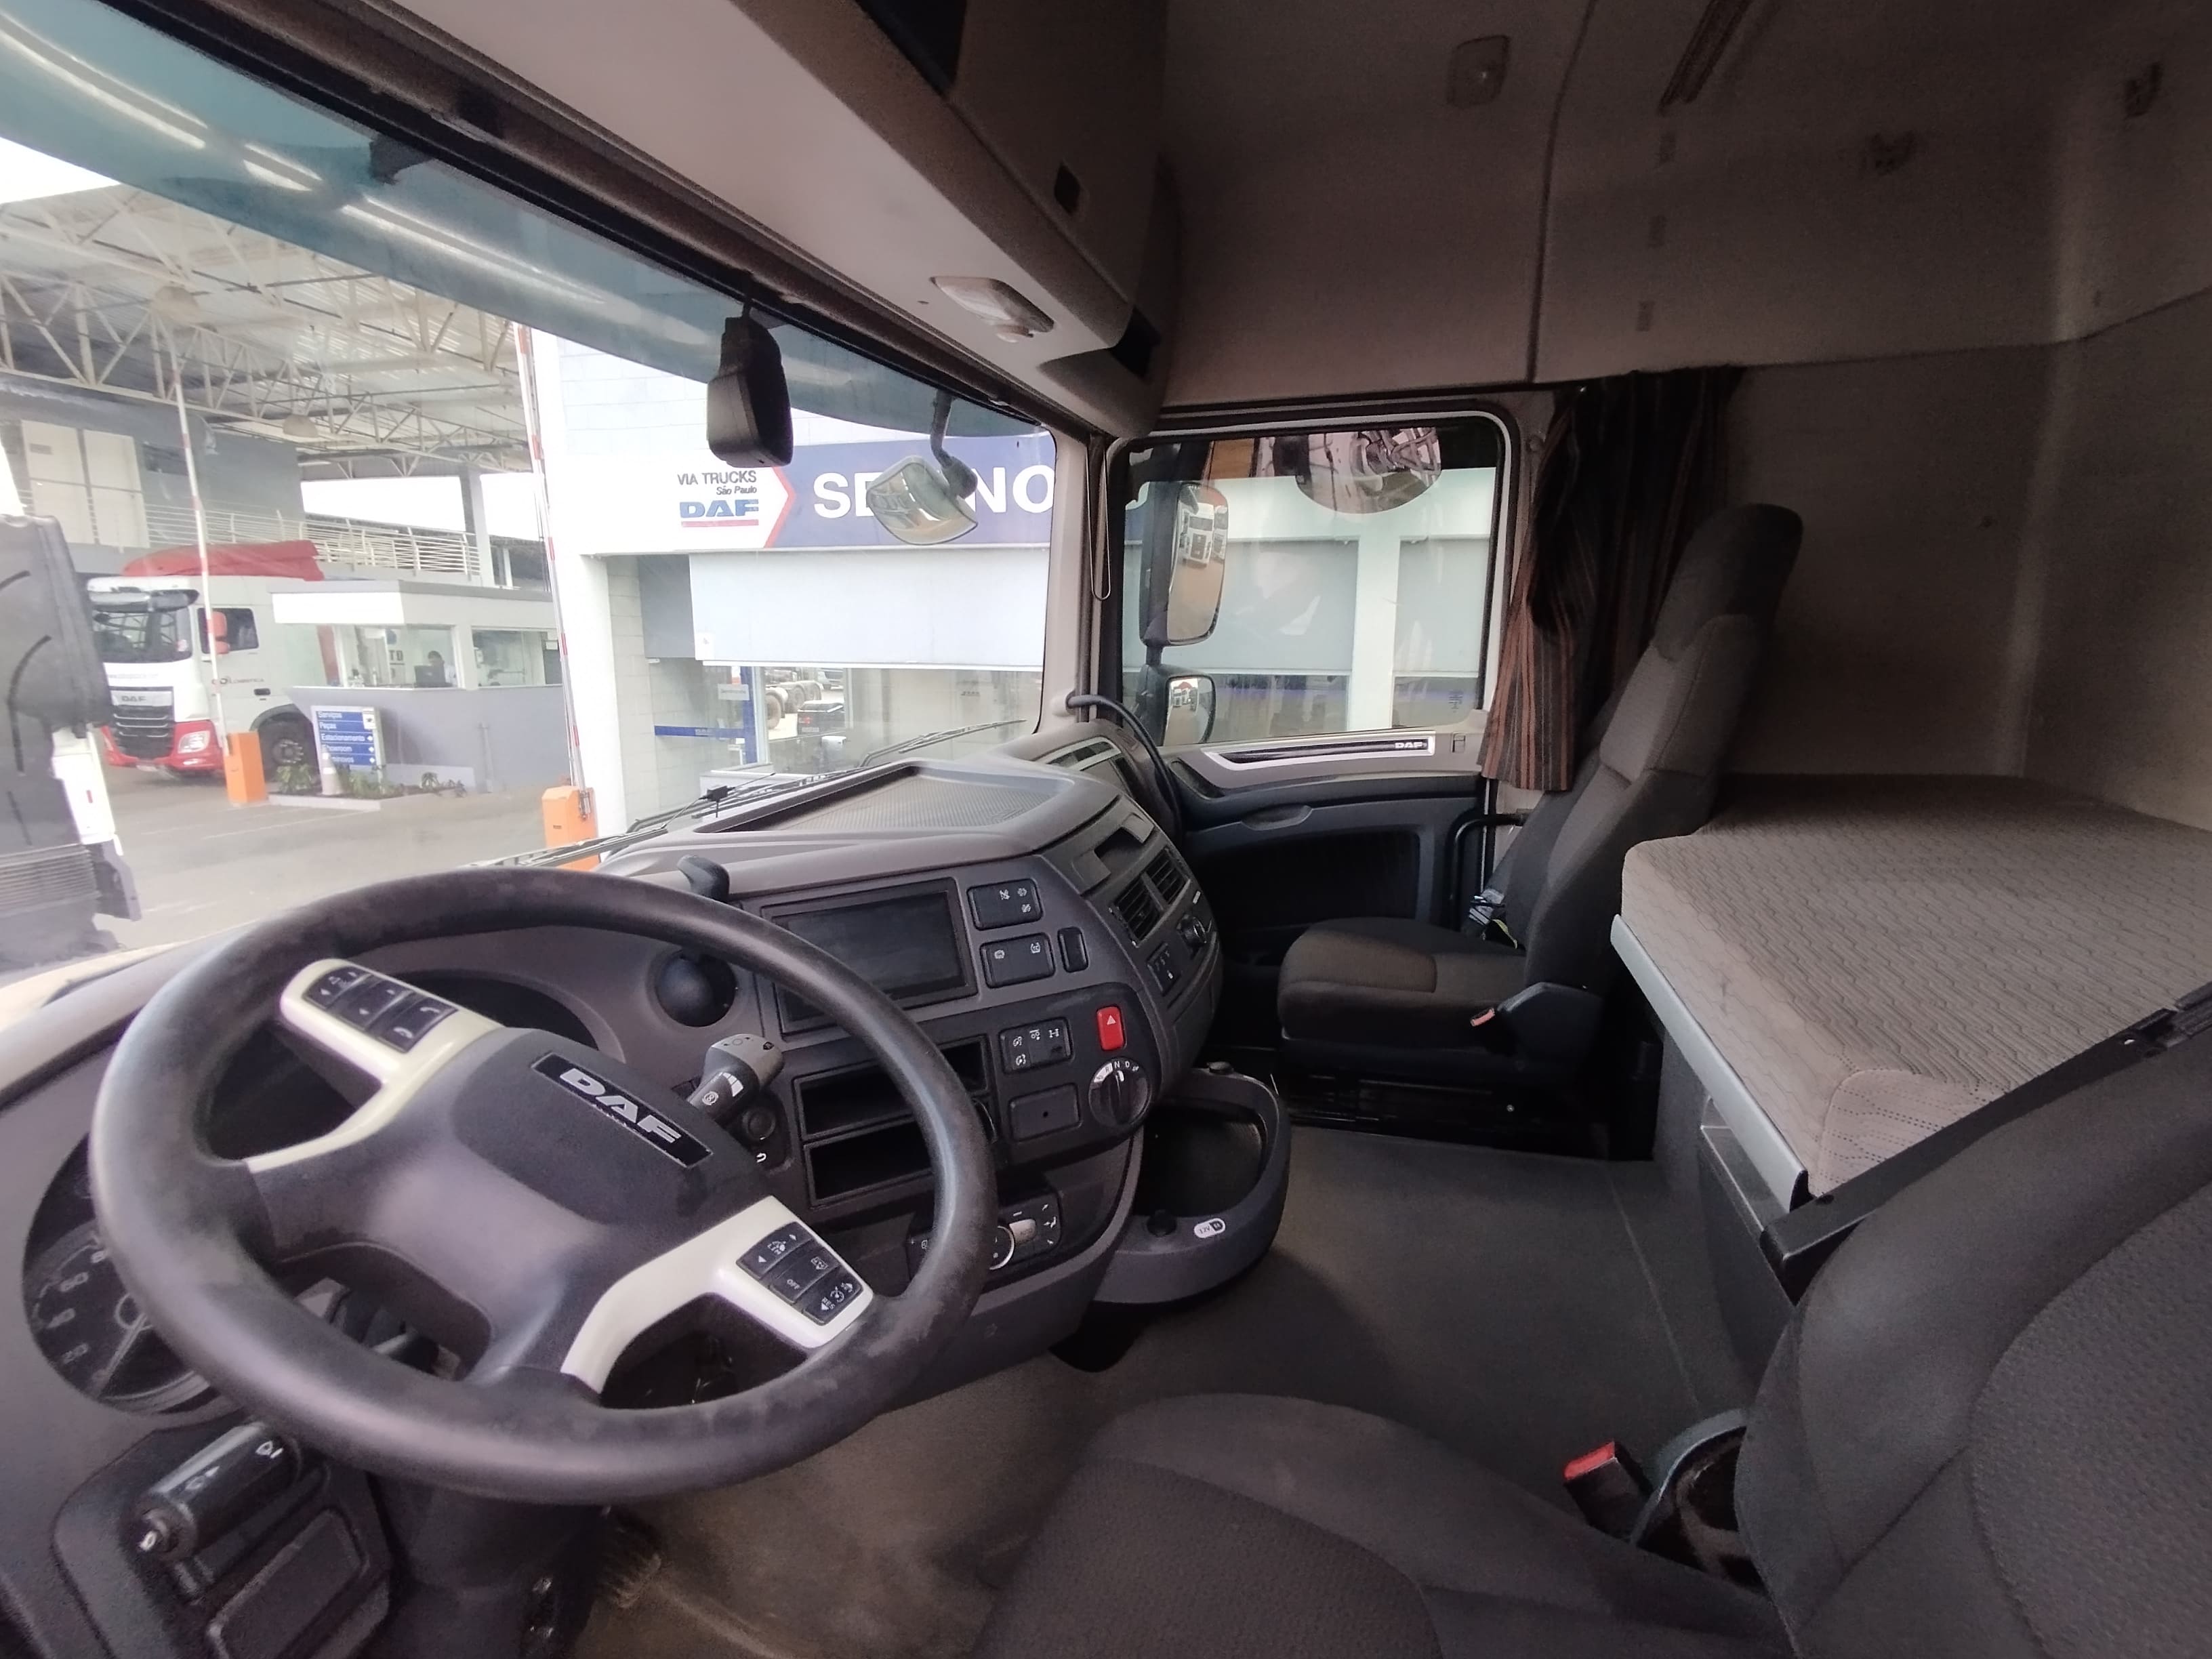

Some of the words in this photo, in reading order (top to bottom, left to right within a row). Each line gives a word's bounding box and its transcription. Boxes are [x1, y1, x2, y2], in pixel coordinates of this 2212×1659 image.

[678, 474, 698, 485] VIA
[702, 470, 757, 484] TRUCKS
[716, 486, 732, 495] São
[734, 486, 757, 494] Paulo
[680, 499, 759, 518] DAF
[1114, 1061, 1120, 1069] N
[560, 1068, 682, 1143] DAF
[787, 1279, 800, 1290] OFF
[821, 1296, 836, 1309] RES
